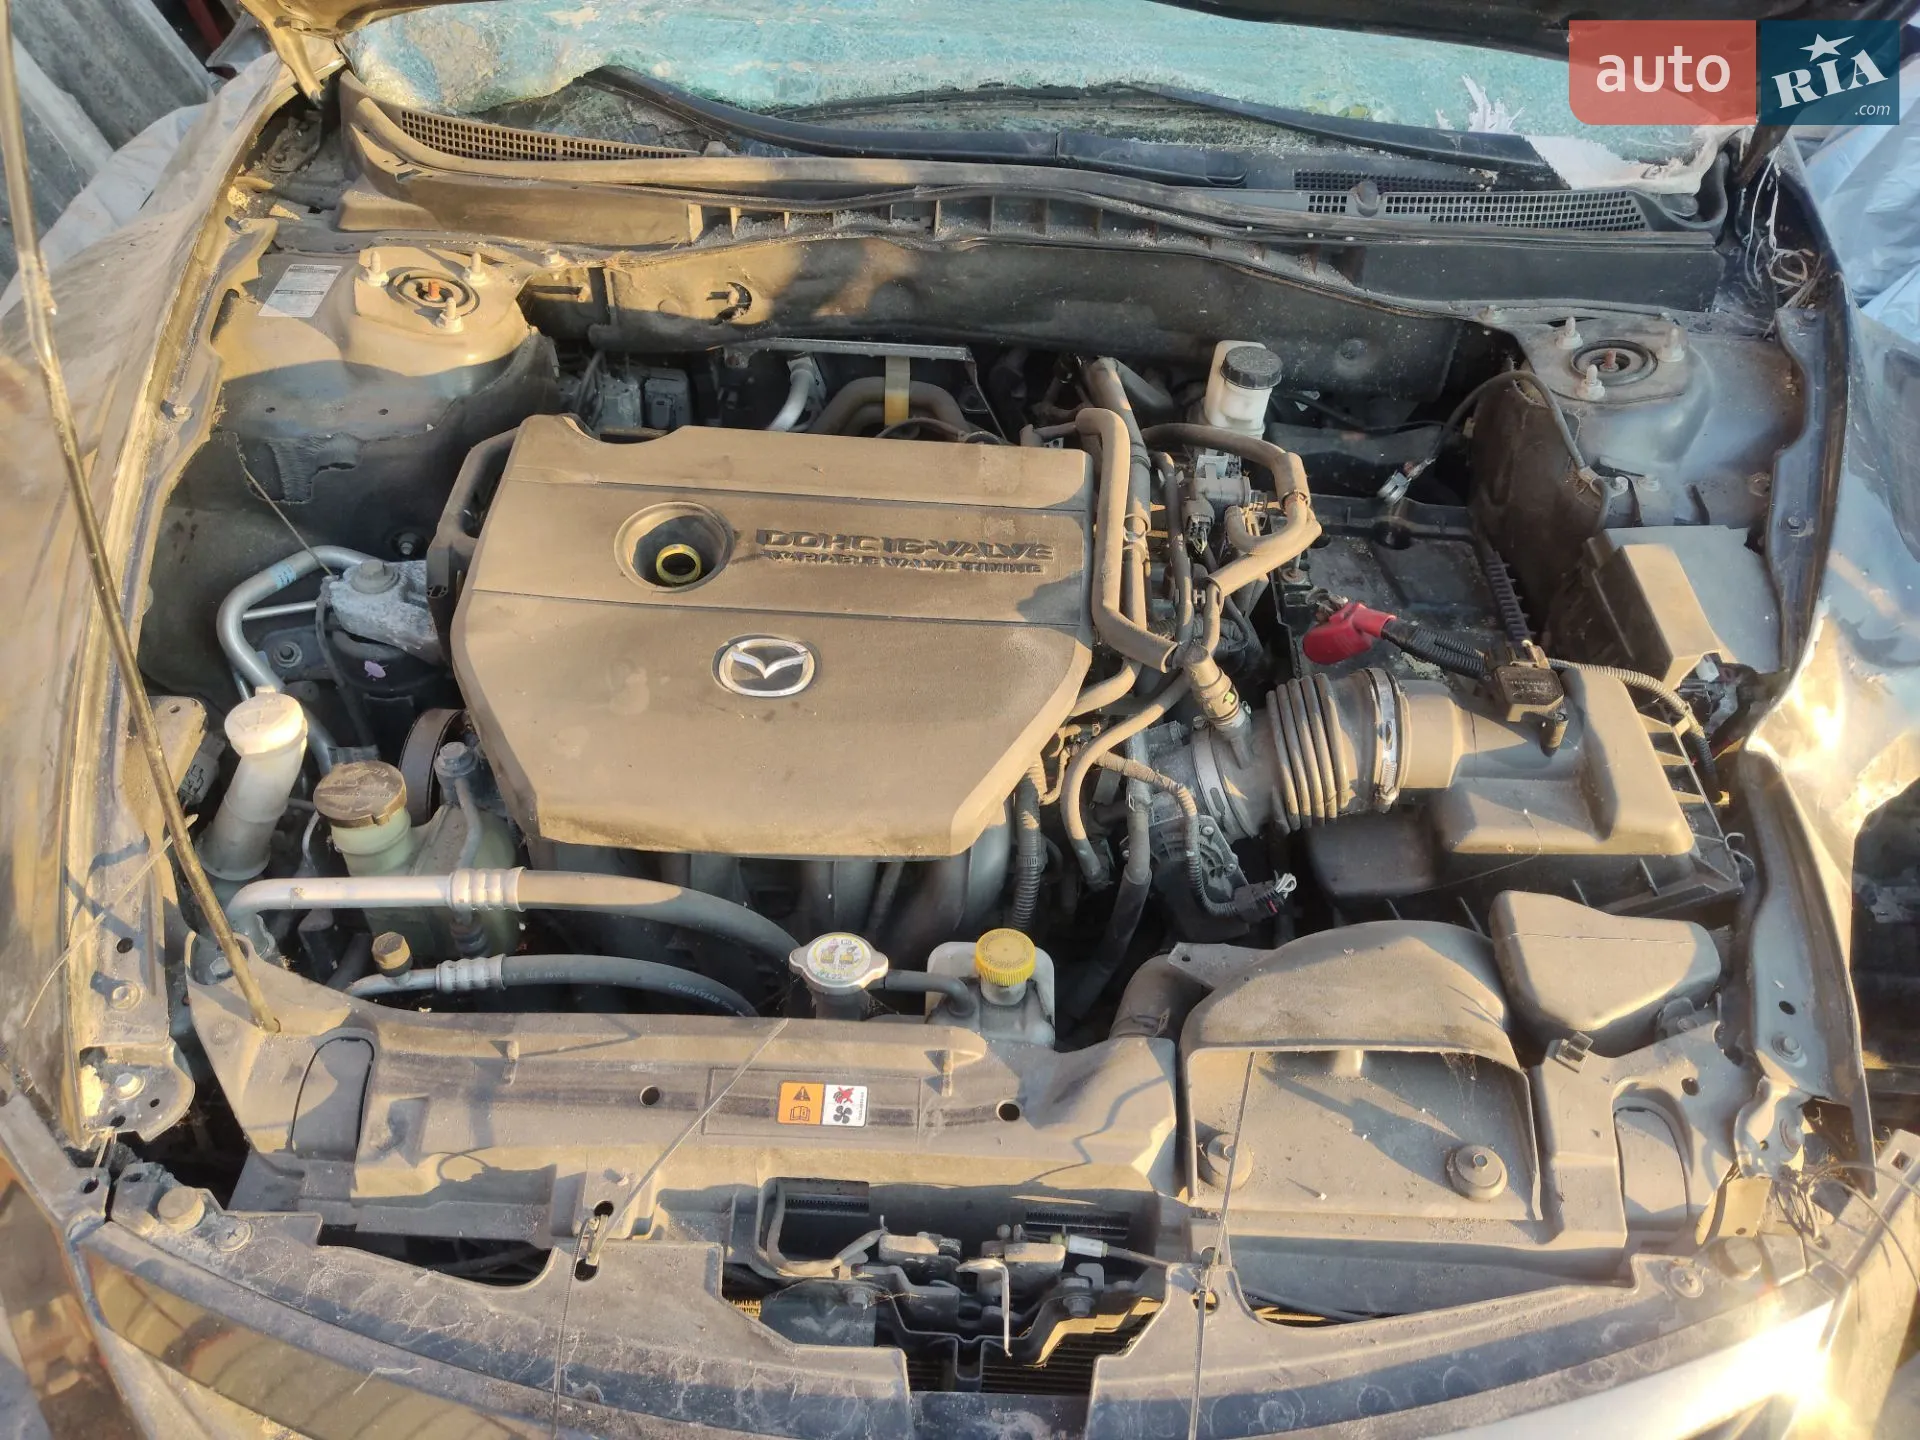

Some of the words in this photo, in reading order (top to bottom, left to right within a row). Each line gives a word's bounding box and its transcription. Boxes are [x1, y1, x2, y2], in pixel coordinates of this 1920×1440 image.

[756, 528, 882, 553] DOHC
[883, 536, 1055, 561] 16-VALVE
[759, 549, 880, 567] VARIABLE
[880, 556, 960, 572] VALVE
[960, 561, 1045, 575] TIMING
[668, 982, 720, 1004] GOODYEAR
